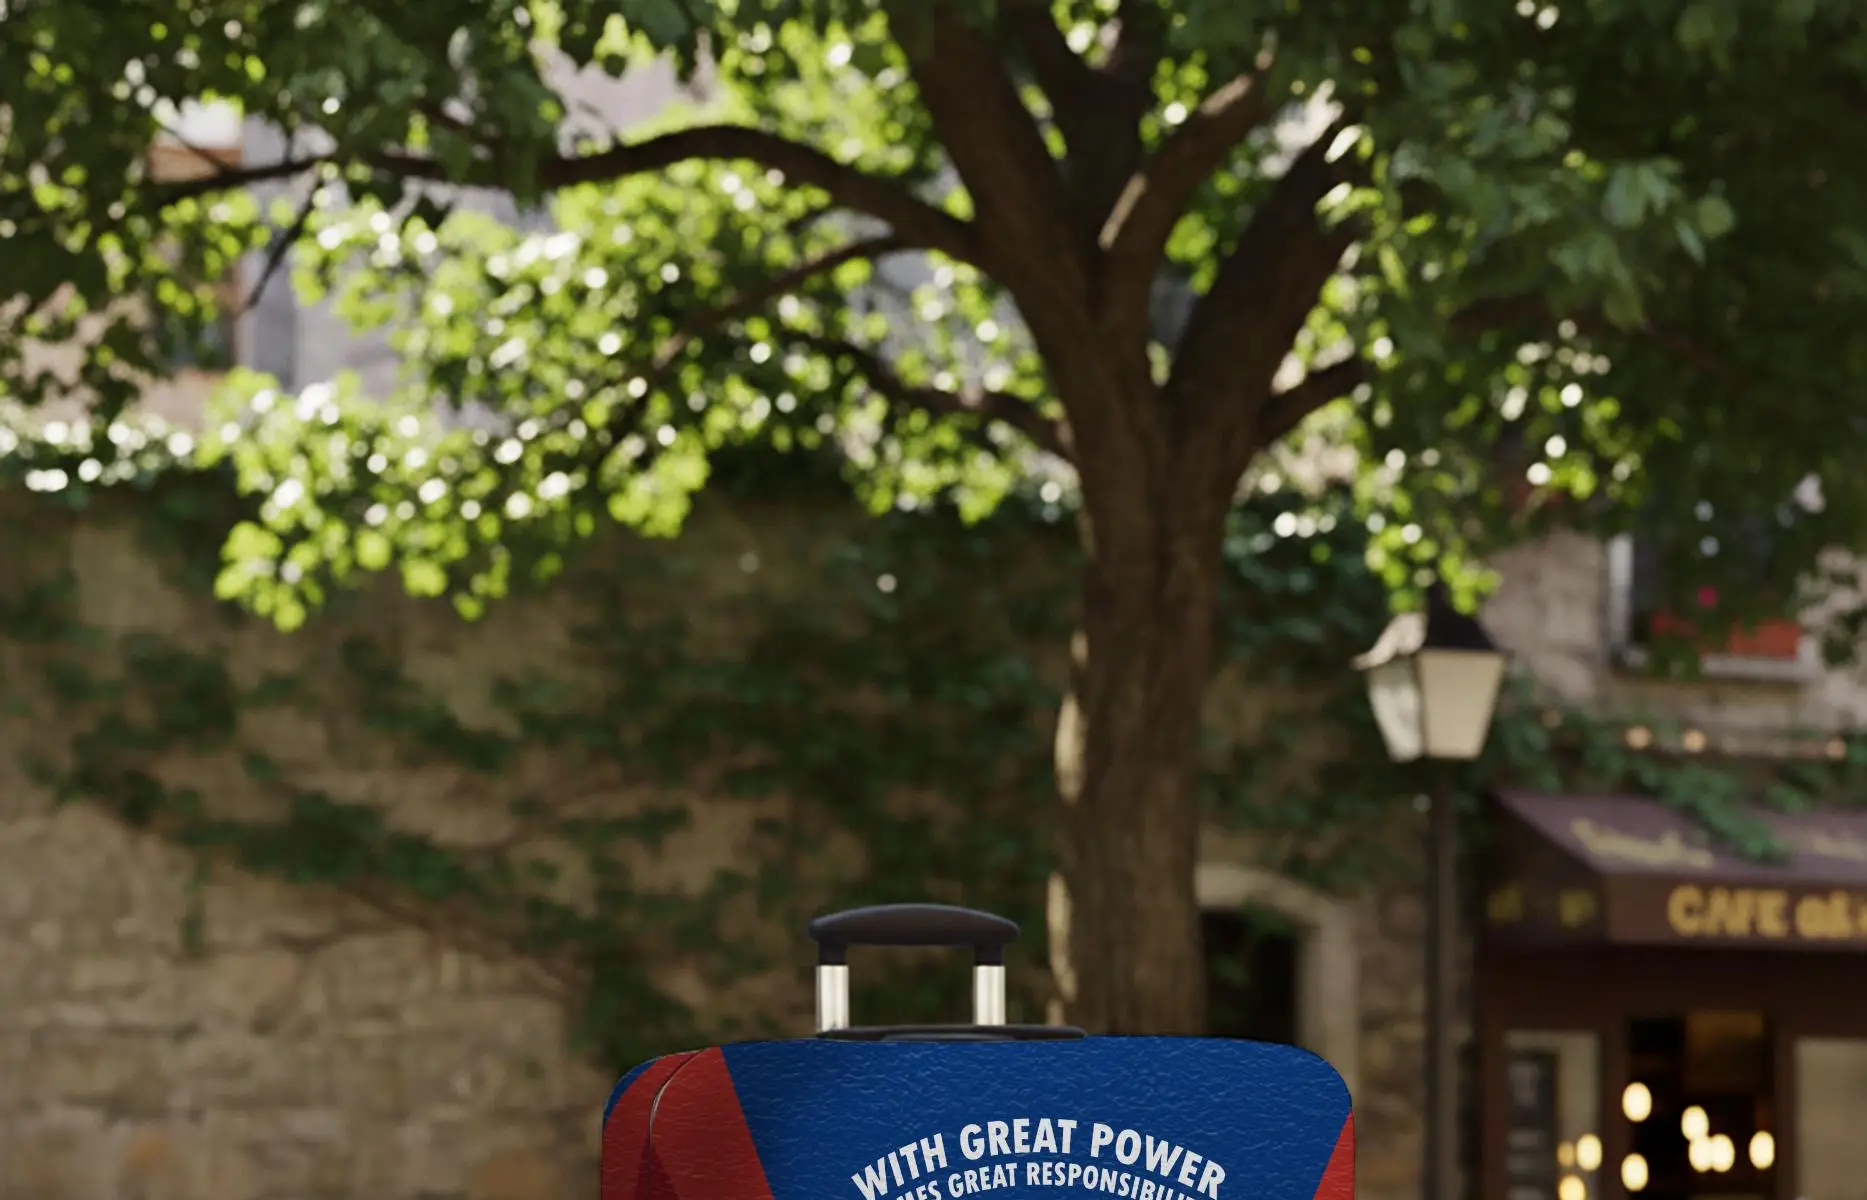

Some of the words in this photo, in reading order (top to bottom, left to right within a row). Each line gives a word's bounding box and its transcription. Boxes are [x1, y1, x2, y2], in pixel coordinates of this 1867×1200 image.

[947, 1162, 1018, 1198] GREAT
[959, 1118, 1078, 1161] GREAT
[1090, 1122, 1227, 1200] POWER
